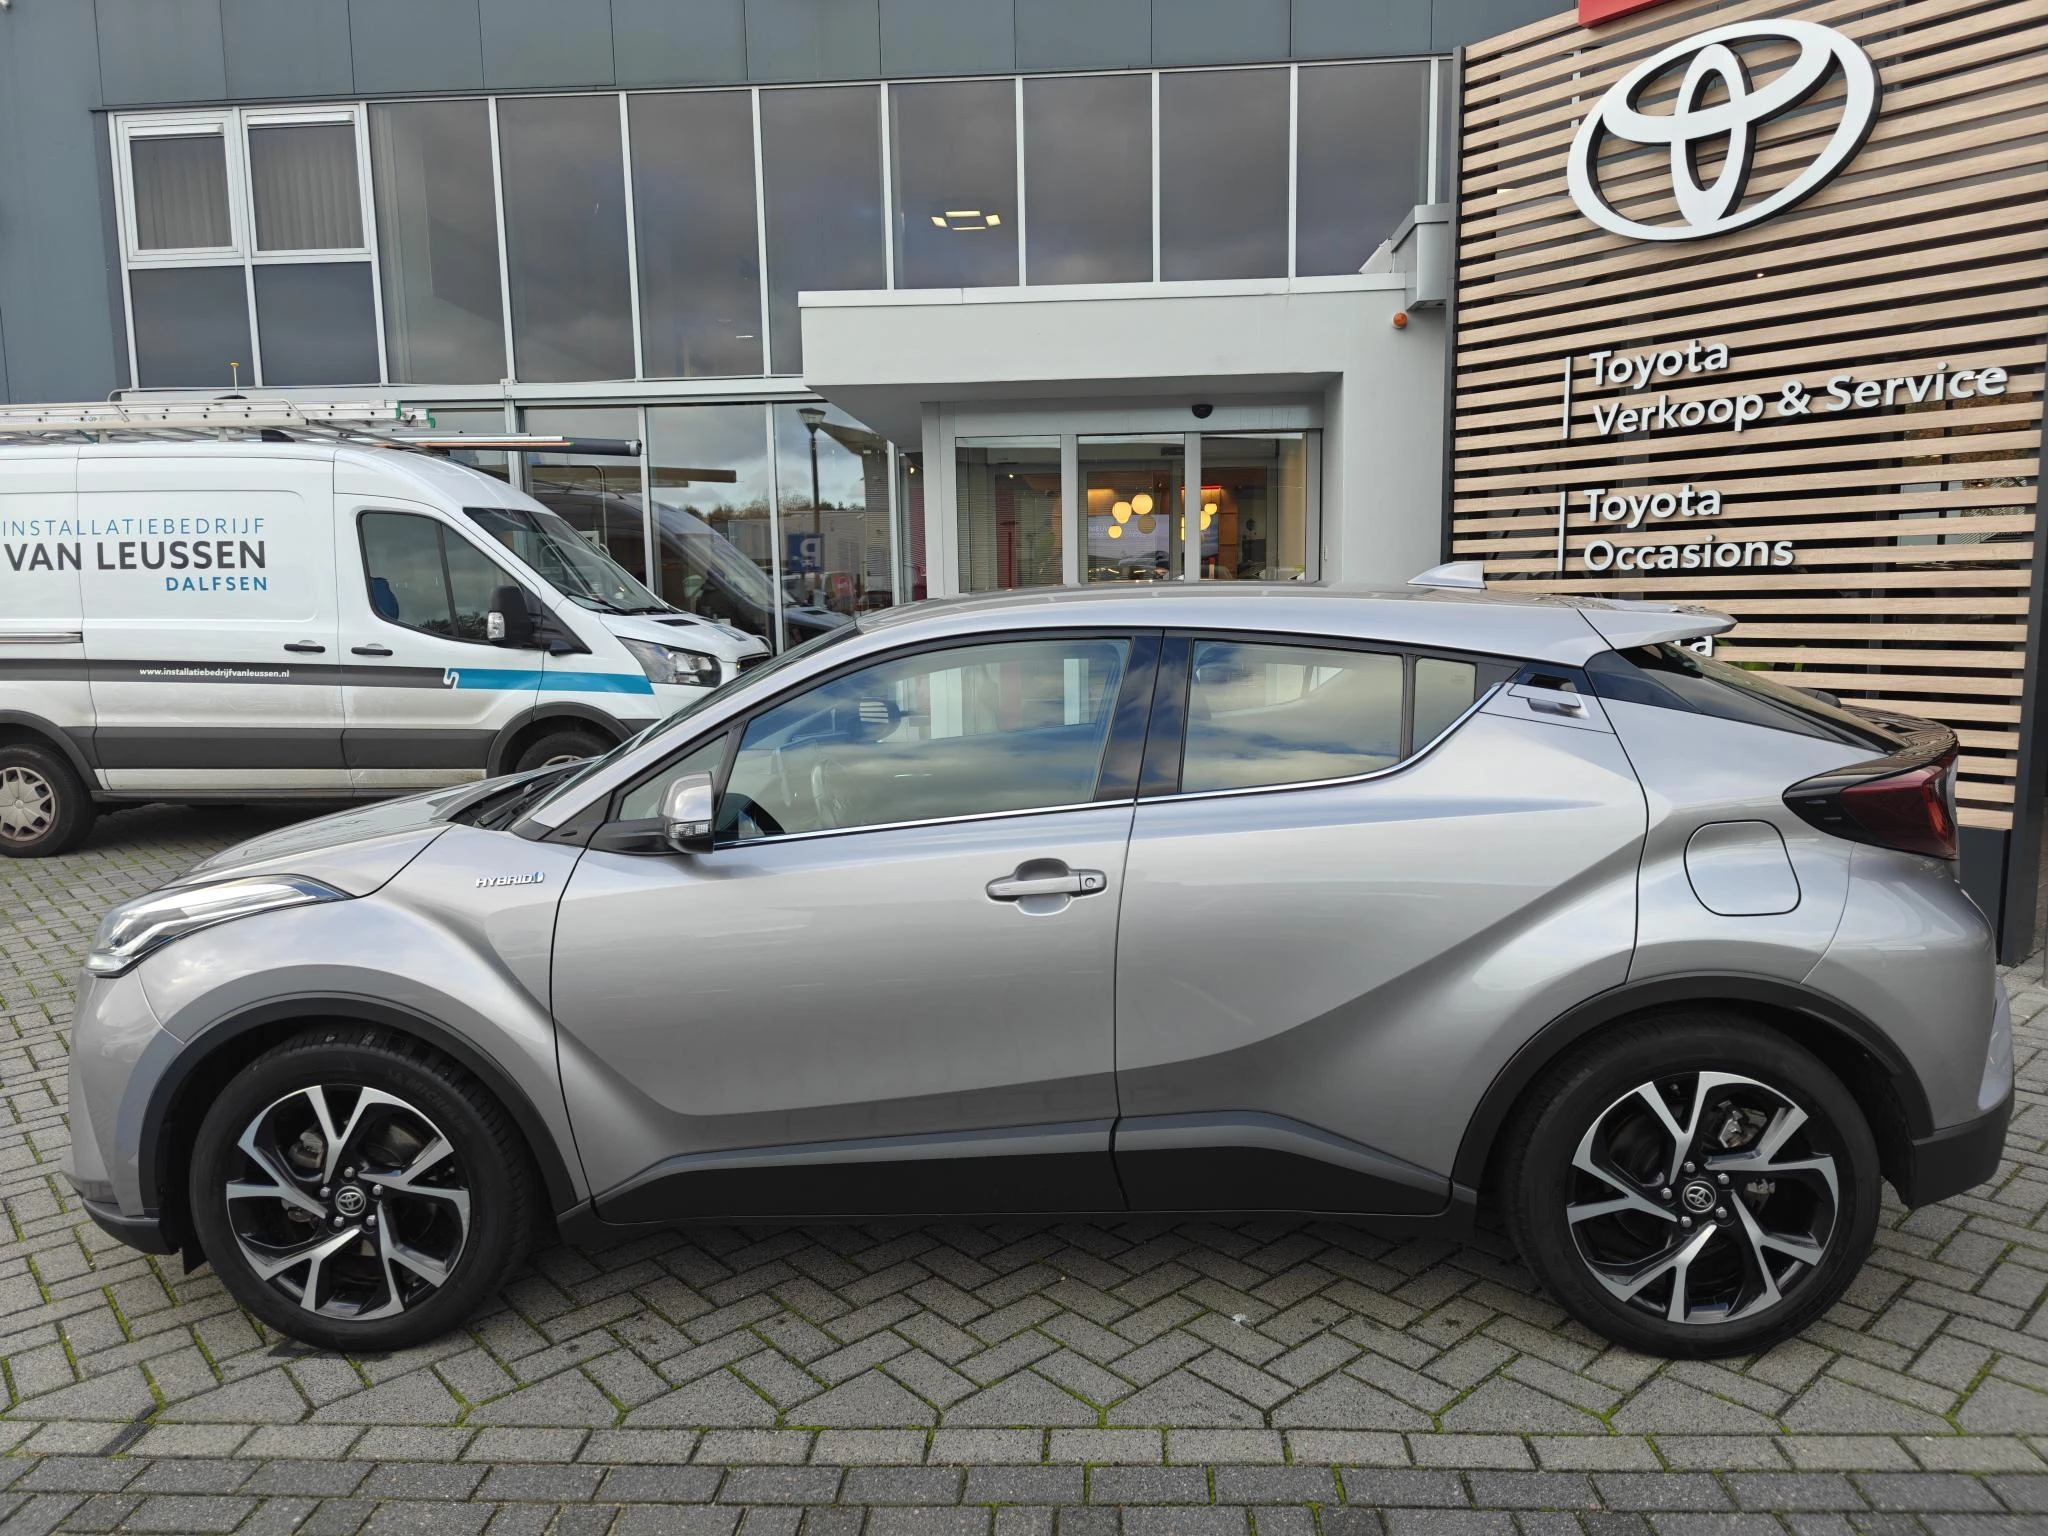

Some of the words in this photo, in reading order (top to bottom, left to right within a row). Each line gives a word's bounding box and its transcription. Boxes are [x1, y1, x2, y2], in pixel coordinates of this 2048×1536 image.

[1588, 340, 1729, 390] Toyota
[1592, 393, 1765, 435] Verkoop
[1776, 379, 1811, 417] &
[1825, 362, 2008, 412] Service
[1583, 483, 1722, 529] Toyota
[3, 517, 265, 537] INSTALLATIEBEDRIJF
[4, 541, 82, 572] VAN
[97, 540, 266, 570] LEUSSEN
[1583, 534, 1794, 572] Occasions
[165, 576, 268, 592] DALFSEN
[139, 667, 290, 679] www.installatiebedrijfvanleussen.nl
[475, 873, 533, 888] HYBRID
